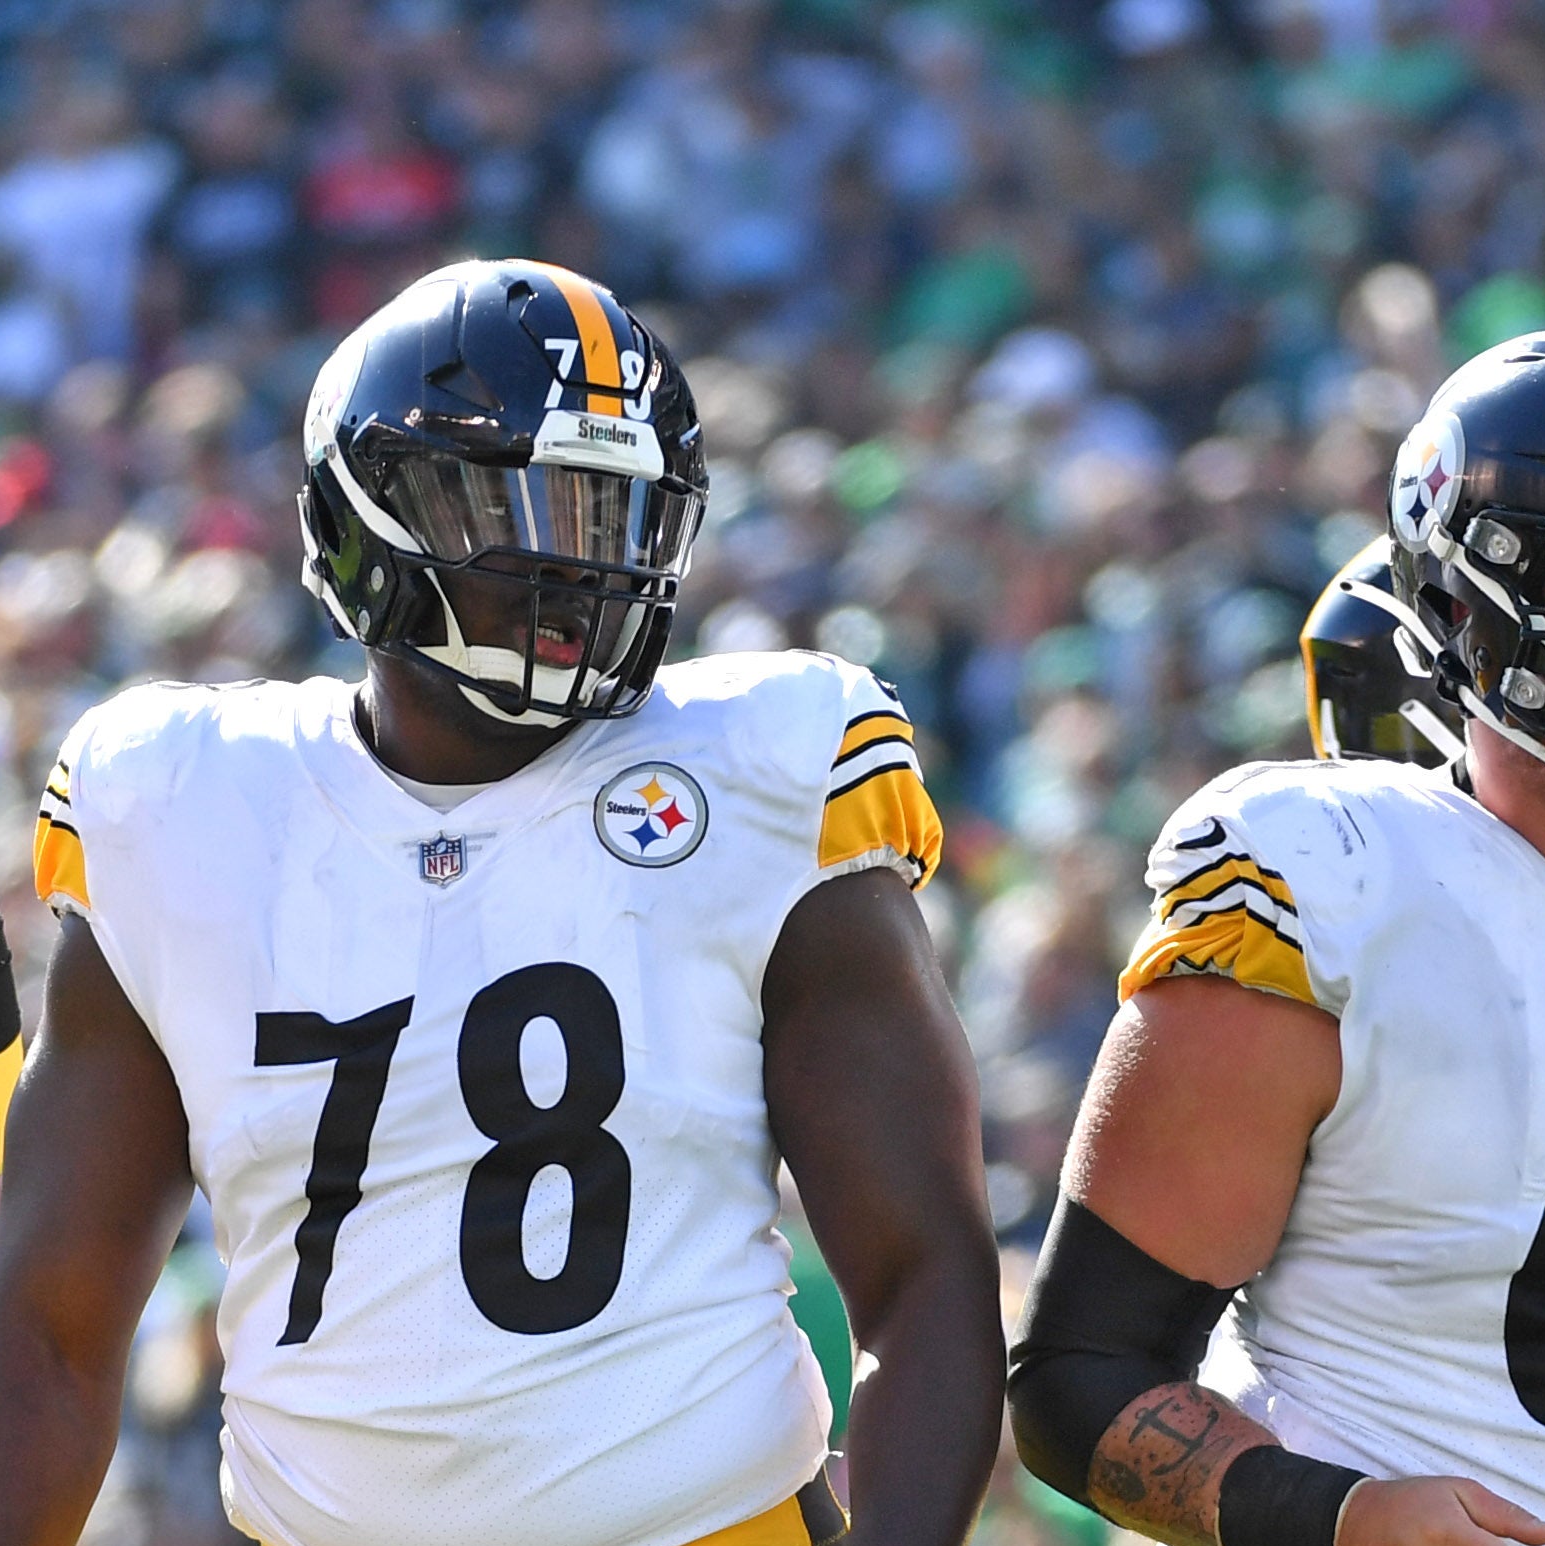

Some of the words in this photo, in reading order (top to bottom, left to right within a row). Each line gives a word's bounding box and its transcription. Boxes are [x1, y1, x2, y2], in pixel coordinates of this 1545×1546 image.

[544, 338, 652, 421] 78
[578, 418, 638, 447] Steelers
[606, 801, 647, 816] Steelers
[426, 855, 459, 876] NFL
[254, 961, 631, 1347] 78
